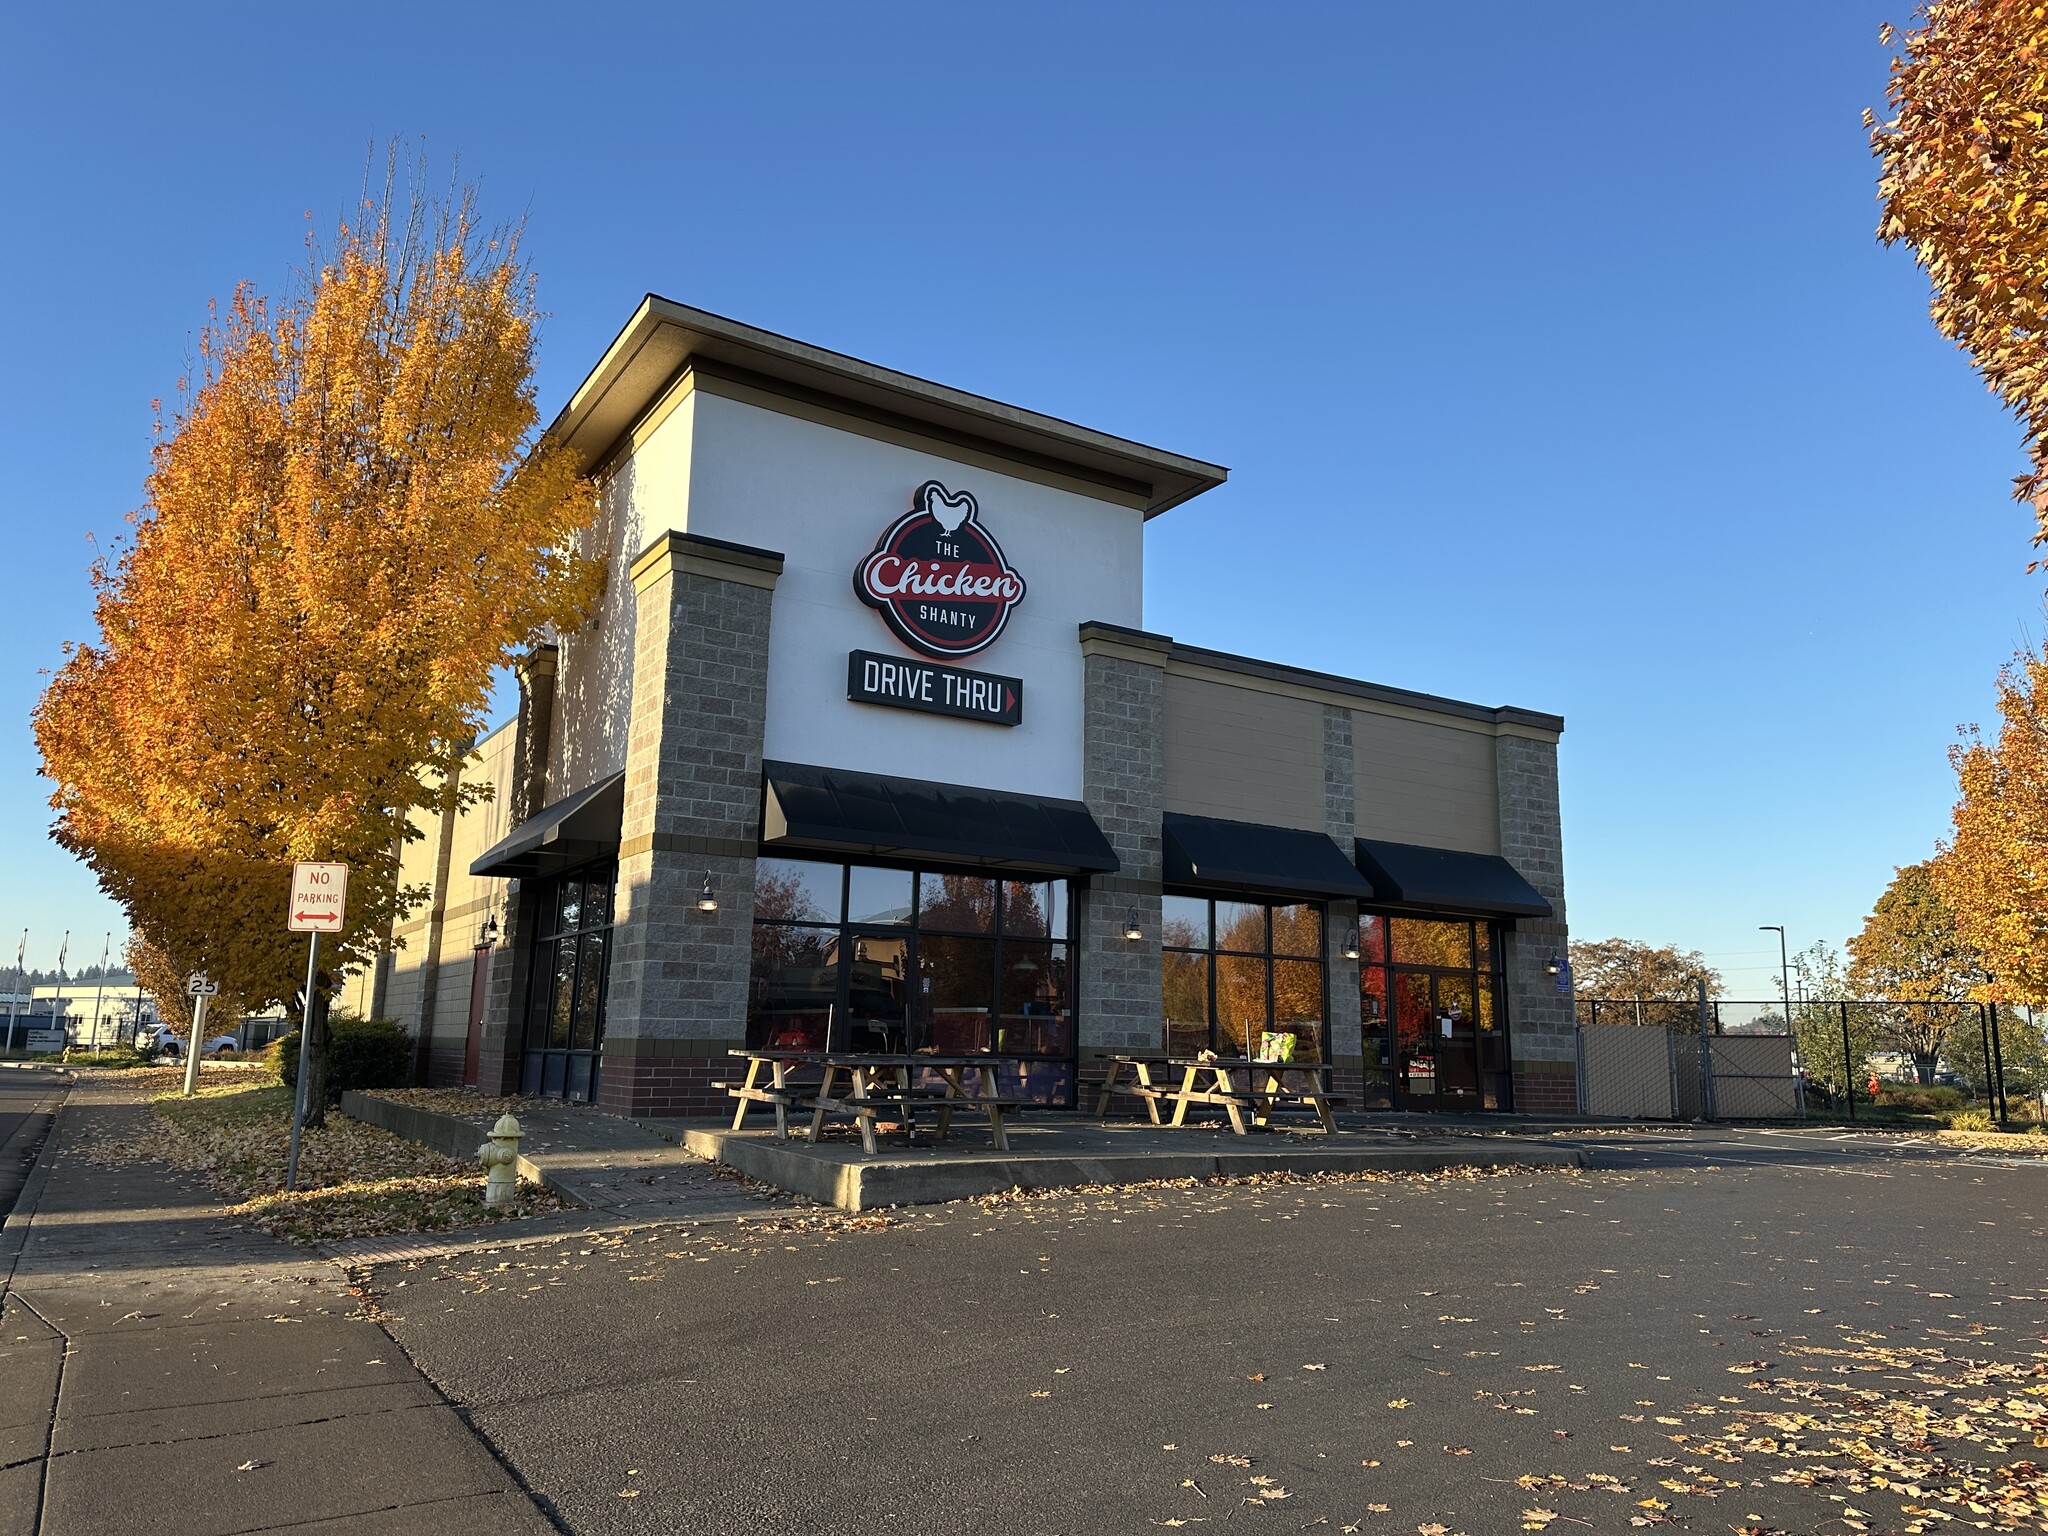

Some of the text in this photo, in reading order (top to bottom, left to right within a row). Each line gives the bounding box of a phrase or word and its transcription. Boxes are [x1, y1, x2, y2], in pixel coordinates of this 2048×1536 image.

[936, 540, 960, 558] THE
[870, 556, 1017, 598] Chicken
[920, 605, 977, 629] SHANTY
[864, 659, 1002, 713] DRIVE THRU
[309, 872, 330, 885] NO
[297, 893, 339, 904] PARKING
[191, 979, 216, 993] 25
